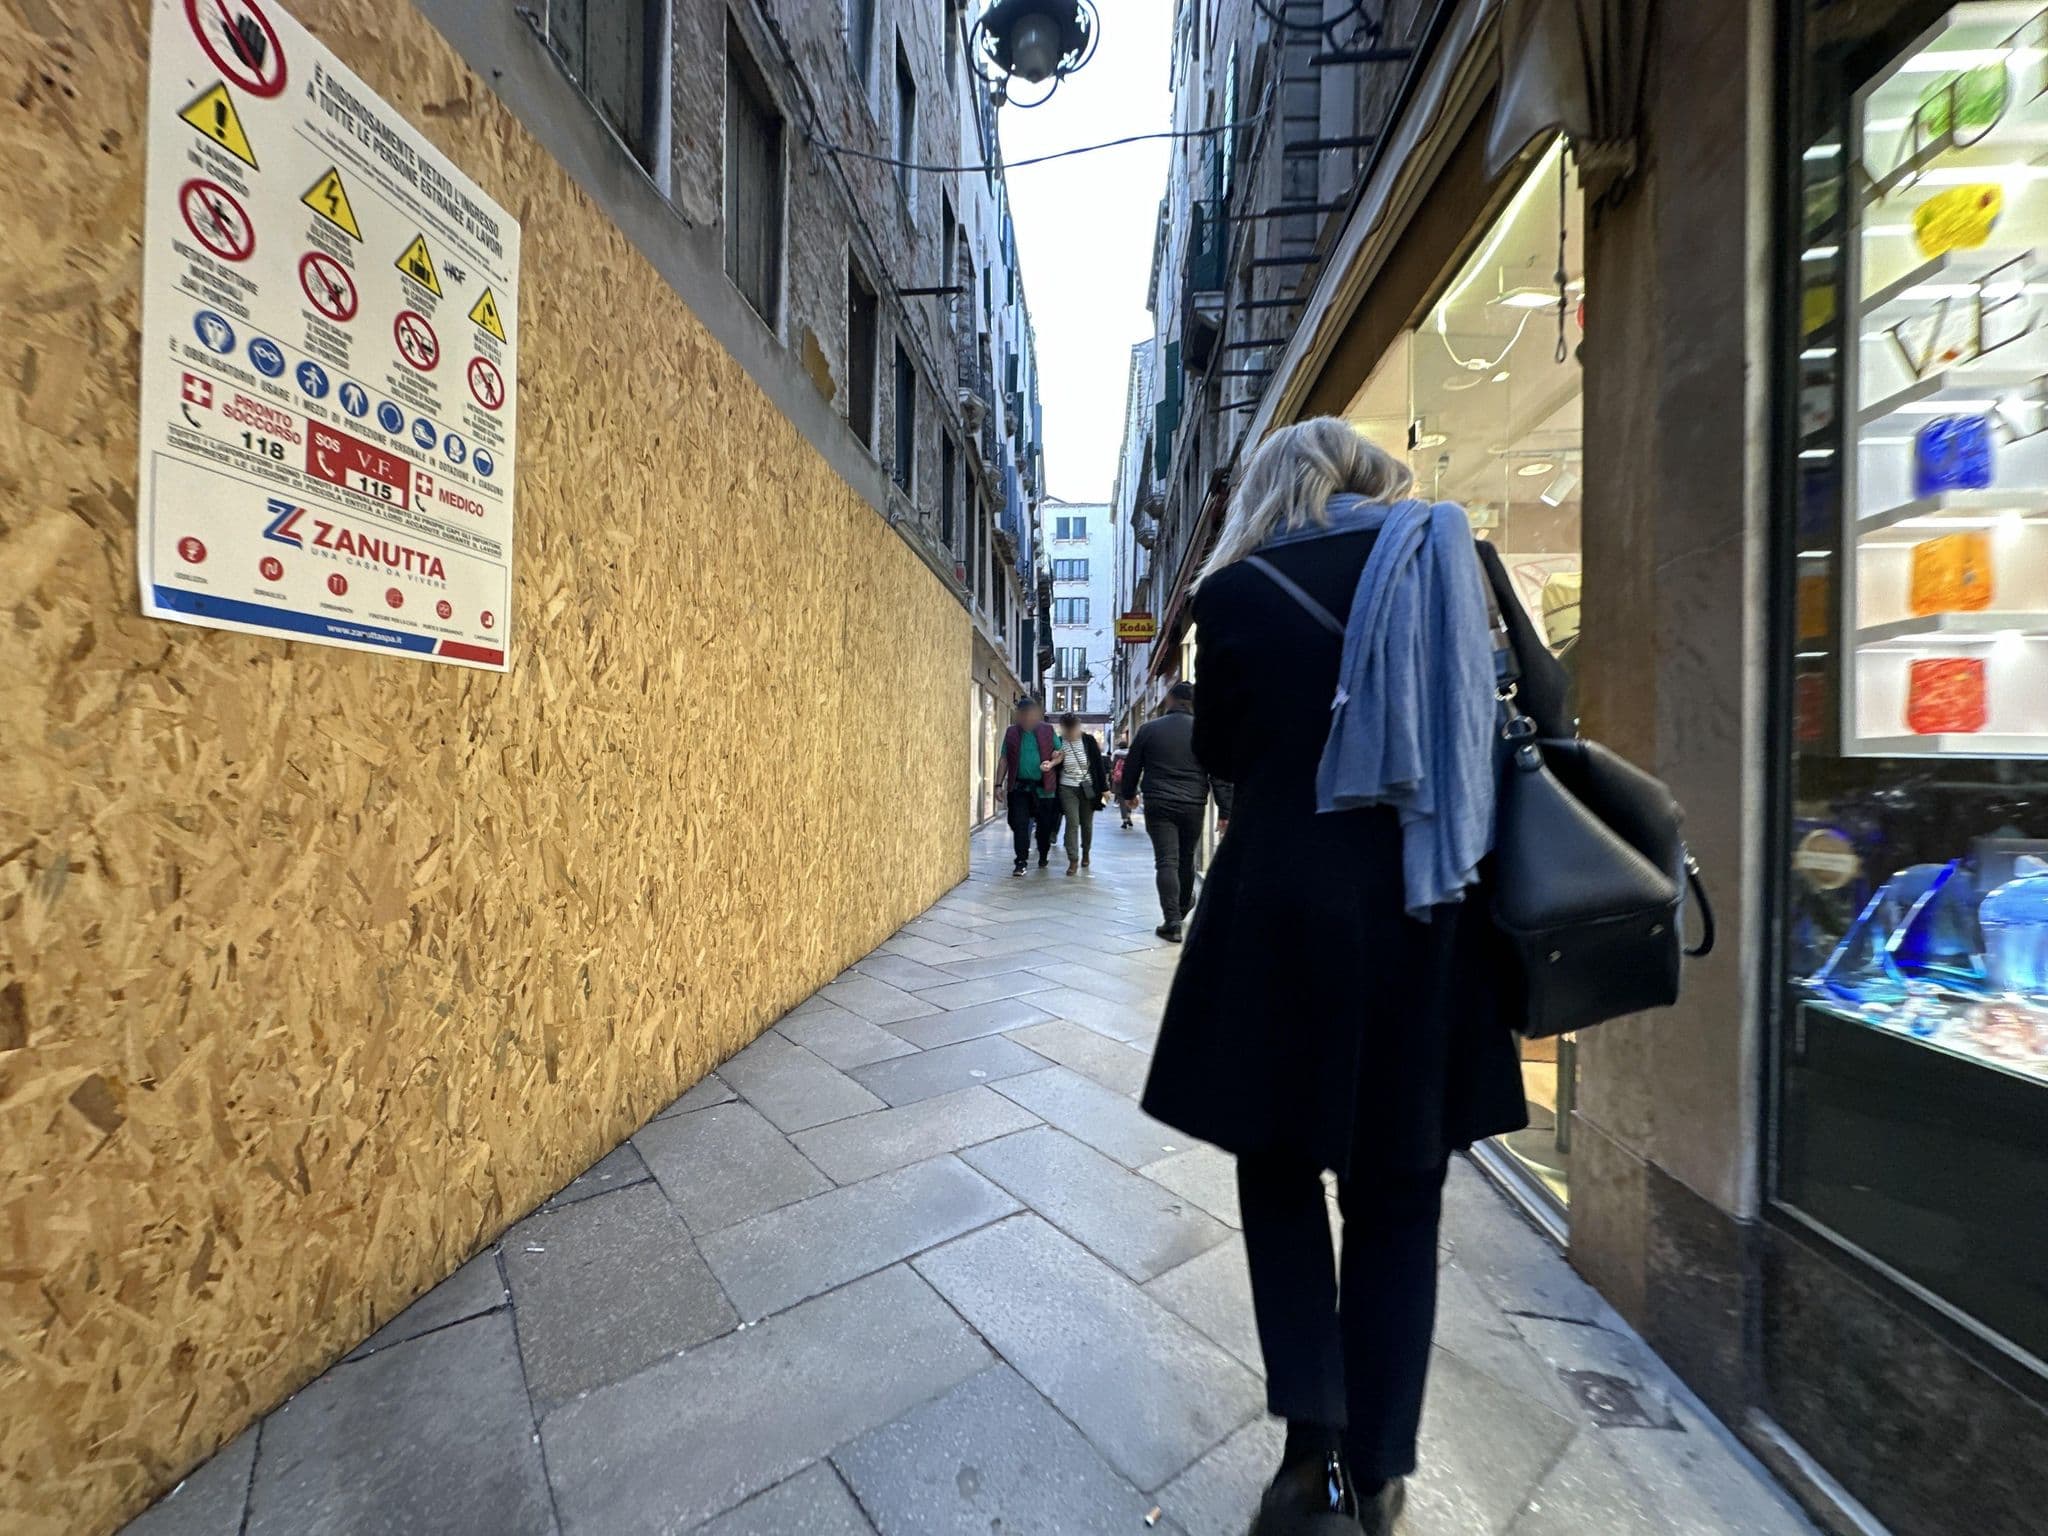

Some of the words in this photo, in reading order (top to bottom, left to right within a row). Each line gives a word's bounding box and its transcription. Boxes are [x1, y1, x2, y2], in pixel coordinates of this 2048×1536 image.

[306, 77, 315, 103] A
[319, 89, 353, 134] TUTTE
[357, 122, 368, 147] LE
[372, 134, 417, 187] PERSONE
[420, 175, 463, 225] ESTRANEE
[466, 215, 474, 235] AI
[476, 224, 502, 259] LAVORI
[417, 154, 452, 198] VIETATO
[454, 186, 498, 238] L'INGRESSO
[222, 402, 301, 446] SOCCORSO
[234, 393, 292, 429] PRONTO
[241, 428, 284, 461] 118
[315, 431, 340, 453] SOS
[356, 449, 392, 479] V.F.
[359, 475, 391, 501] 115
[439, 487, 483, 518] MEDICO
[313, 519, 446, 580] ZANUTTA
[311, 547, 337, 561] UNA
[346, 556, 377, 571] CASA
[386, 567, 400, 577] DA
[407, 573, 446, 589] VIVERE
[1119, 622, 1154, 632] Kodak
